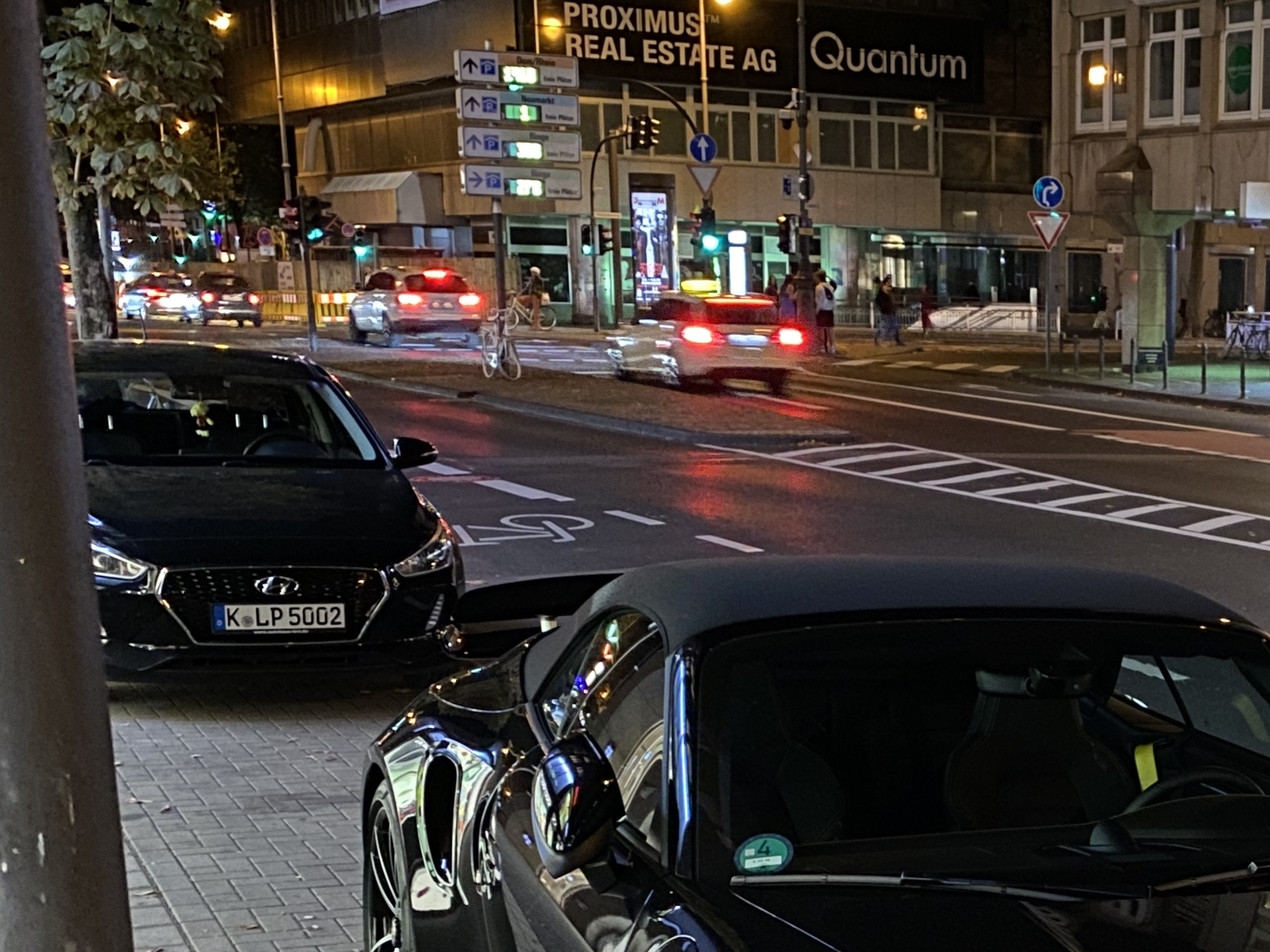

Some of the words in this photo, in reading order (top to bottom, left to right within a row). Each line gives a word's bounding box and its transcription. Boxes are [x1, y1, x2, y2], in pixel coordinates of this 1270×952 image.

[564, 2, 700, 37] PROXIMUS
[565, 33, 635, 62] REAL
[643, 39, 735, 69] ESTATE
[742, 48, 777, 72] AG
[810, 30, 967, 80] Quantum
[227, 608, 240, 626] K
[256, 608, 283, 626] LP
[288, 607, 342, 625] 5002
[757, 840, 770, 856] 4
